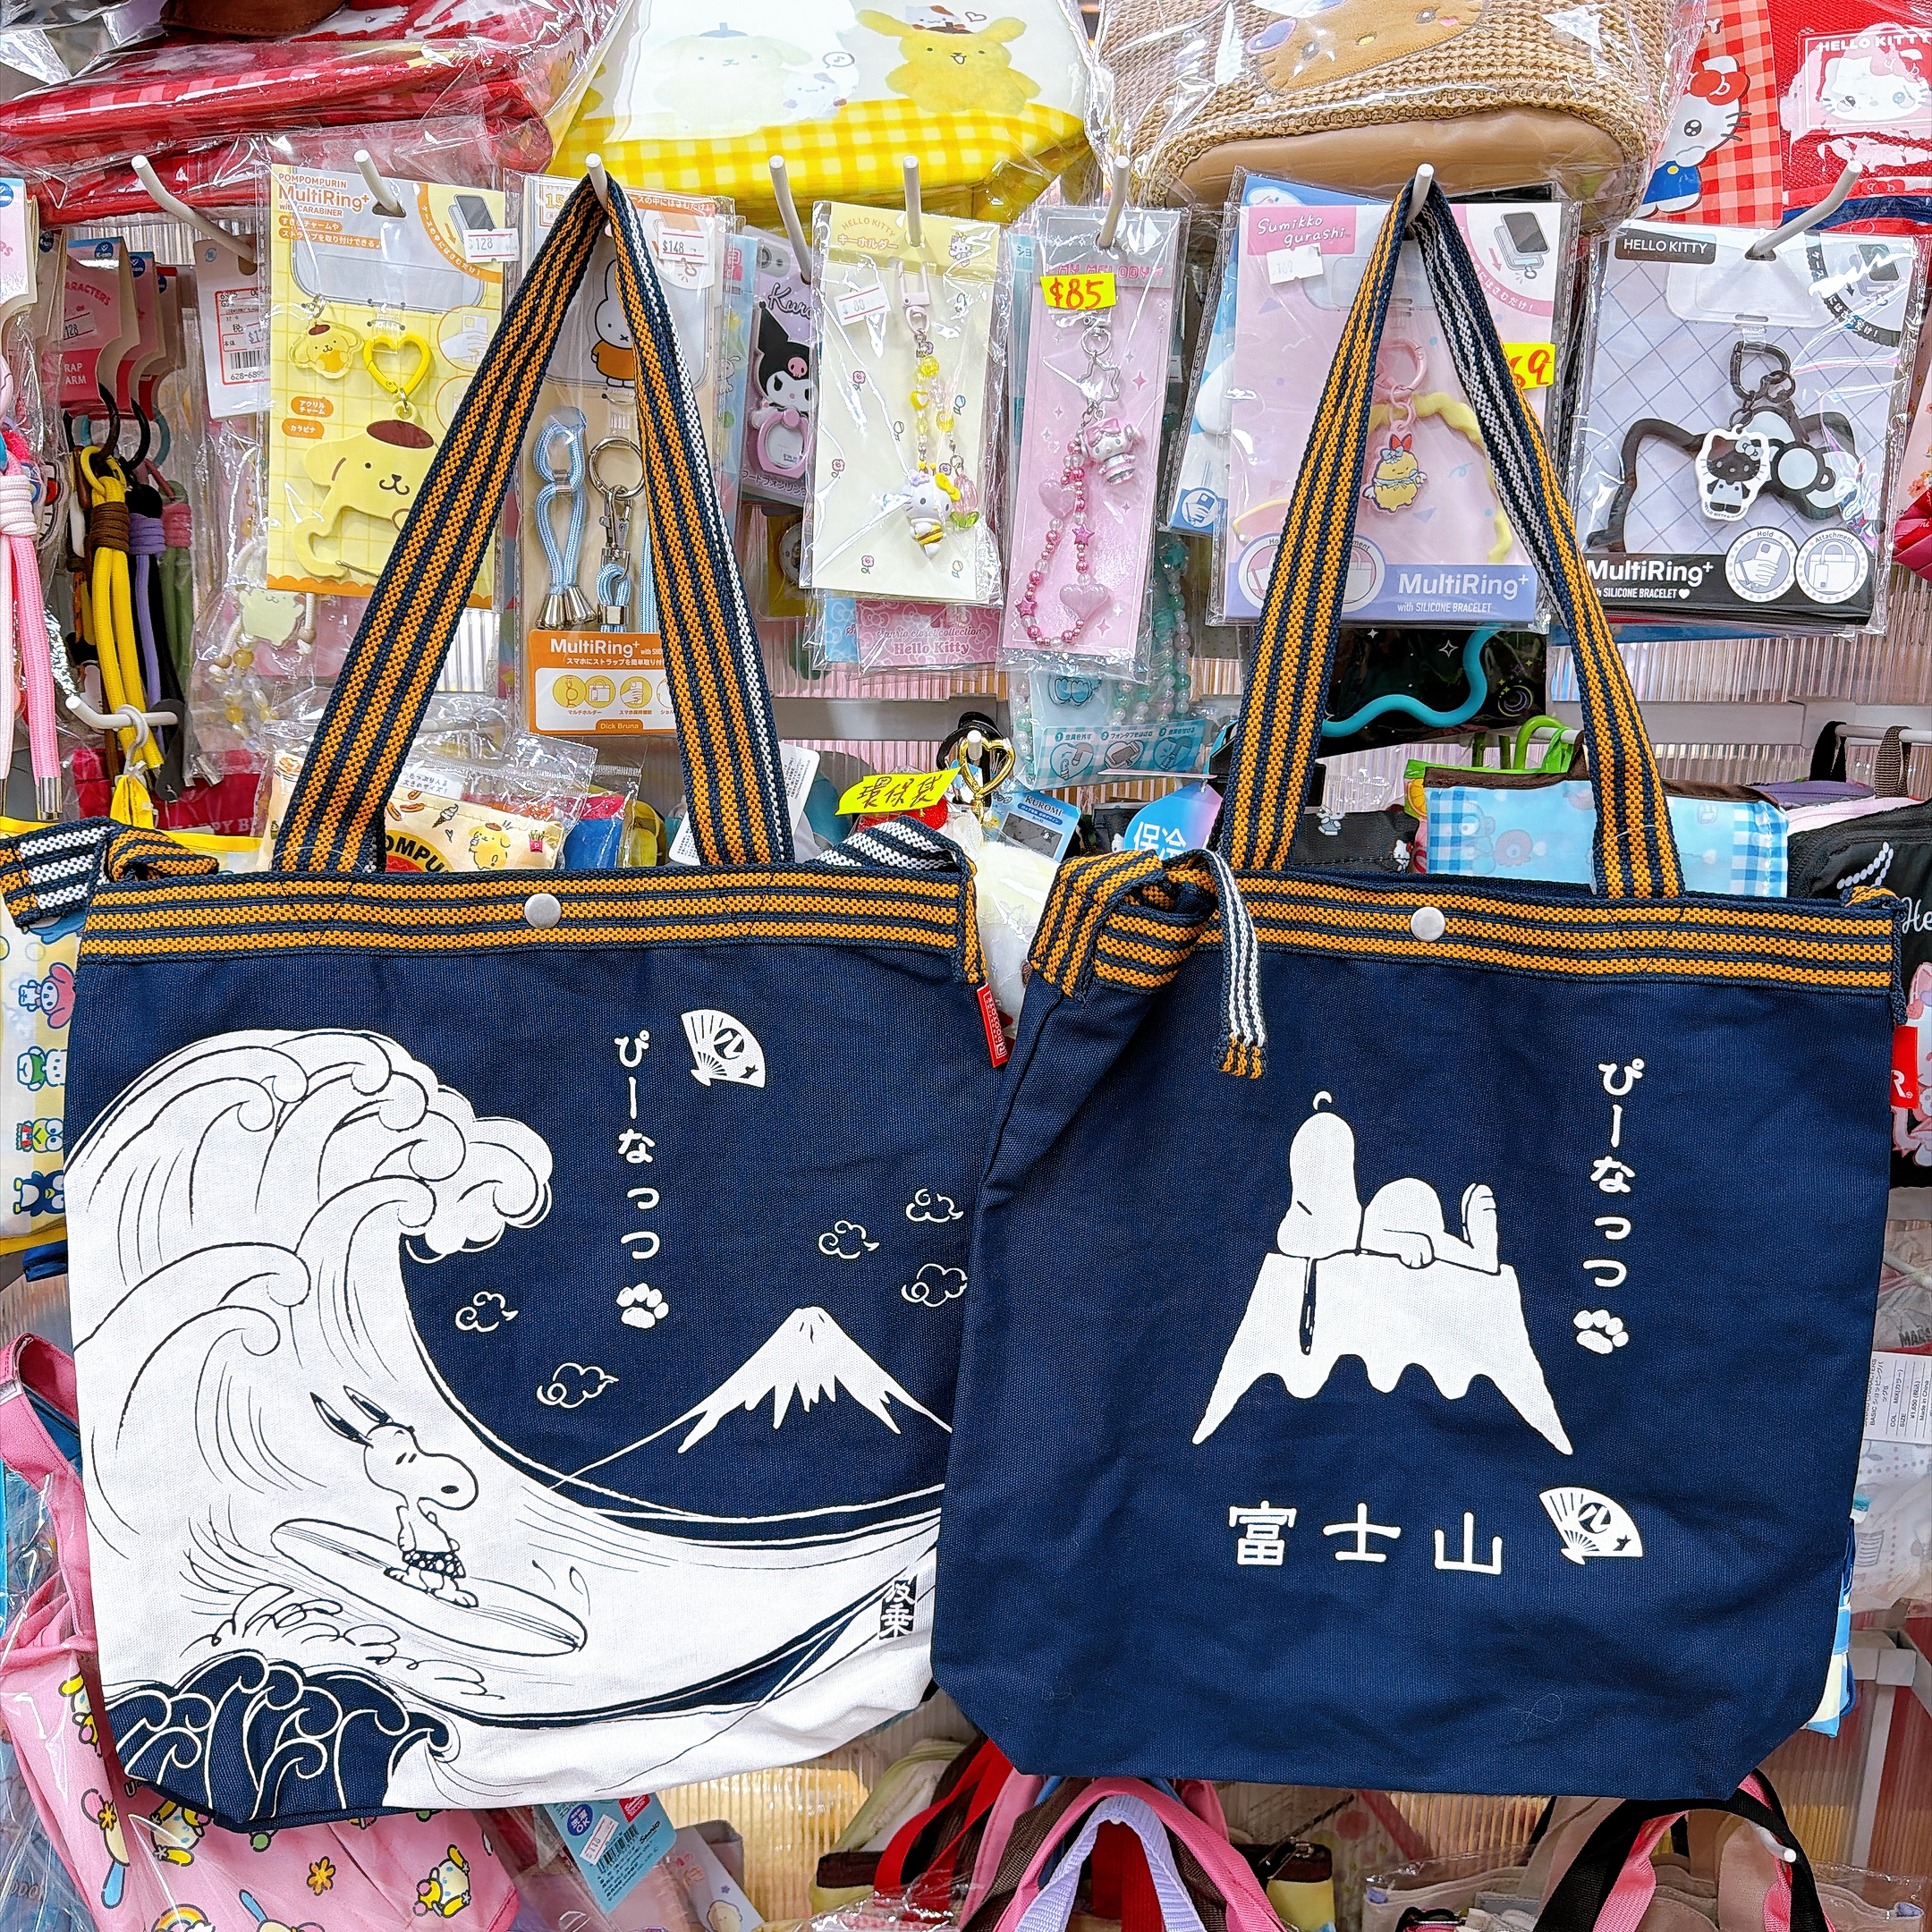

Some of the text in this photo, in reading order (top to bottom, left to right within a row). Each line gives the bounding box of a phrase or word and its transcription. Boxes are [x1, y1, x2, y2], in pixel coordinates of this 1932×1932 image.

[1818, 36, 1870, 52] HELLO
[278, 173, 347, 190] POMPOMPURIN
[298, 205, 343, 217] CARABINER
[842, 217, 896, 238] HELLO KITTY
[1257, 214, 1323, 235] Sumikko
[663, 240, 684, 254] $148
[837, 233, 899, 250] キーホルダー
[1623, 238, 1708, 255] HELLO KITTY
[1049, 277, 1105, 310] $85
[300, 400, 326, 409] アクリル
[300, 407, 326, 415] チャーム
[290, 425, 317, 434] カラビナ
[1815, 532, 1855, 545] Attachment
[1398, 573, 1530, 601] MultiRing+
[1603, 587, 1638, 598] SILICONE
[1639, 588, 1678, 599] BRACELET
[1397, 602, 1492, 614] with SILICONE BRACELET
[938, 627, 984, 637] collection
[894, 641, 970, 655] Hello Kitty
[1024, 794, 1063, 818] KUROMI
[386, 835, 449, 873] OMPU
[614, 1029, 660, 1261] ぴーなっつ
[1581, 1057, 1646, 1289] ぴーなっつ
[1869, 1406, 1877, 1426] BASIC
[1919, 1402, 1927, 1421] Made
[1227, 1499, 1504, 1576] 富士山
[576, 1817, 591, 1834] OK
